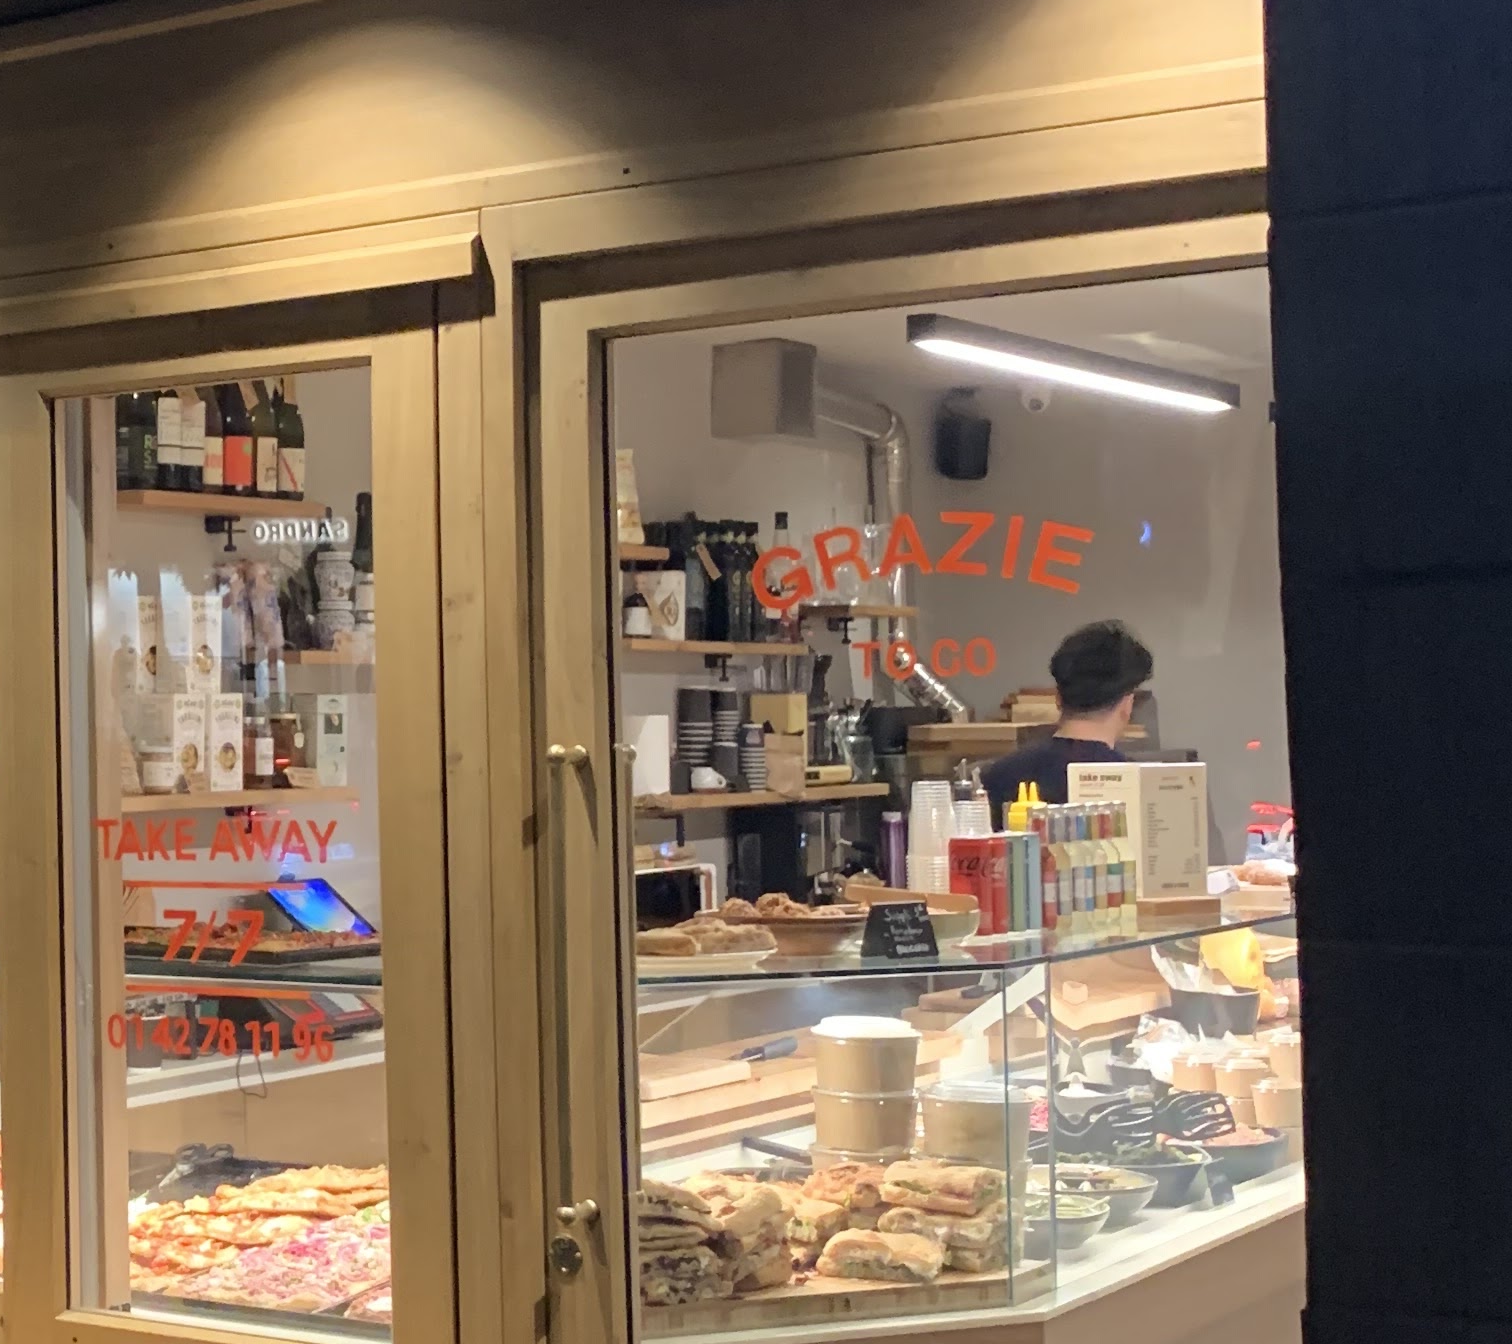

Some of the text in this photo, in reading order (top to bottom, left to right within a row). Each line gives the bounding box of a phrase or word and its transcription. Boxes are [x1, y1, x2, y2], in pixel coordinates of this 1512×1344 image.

[752, 511, 1095, 610] GRAZIE
[851, 640, 917, 680] TO
[96, 819, 338, 864] TAKE AWAY
[163, 909, 265, 967] 7/7
[107, 1015, 335, 1063] 01 42 78 11 96
